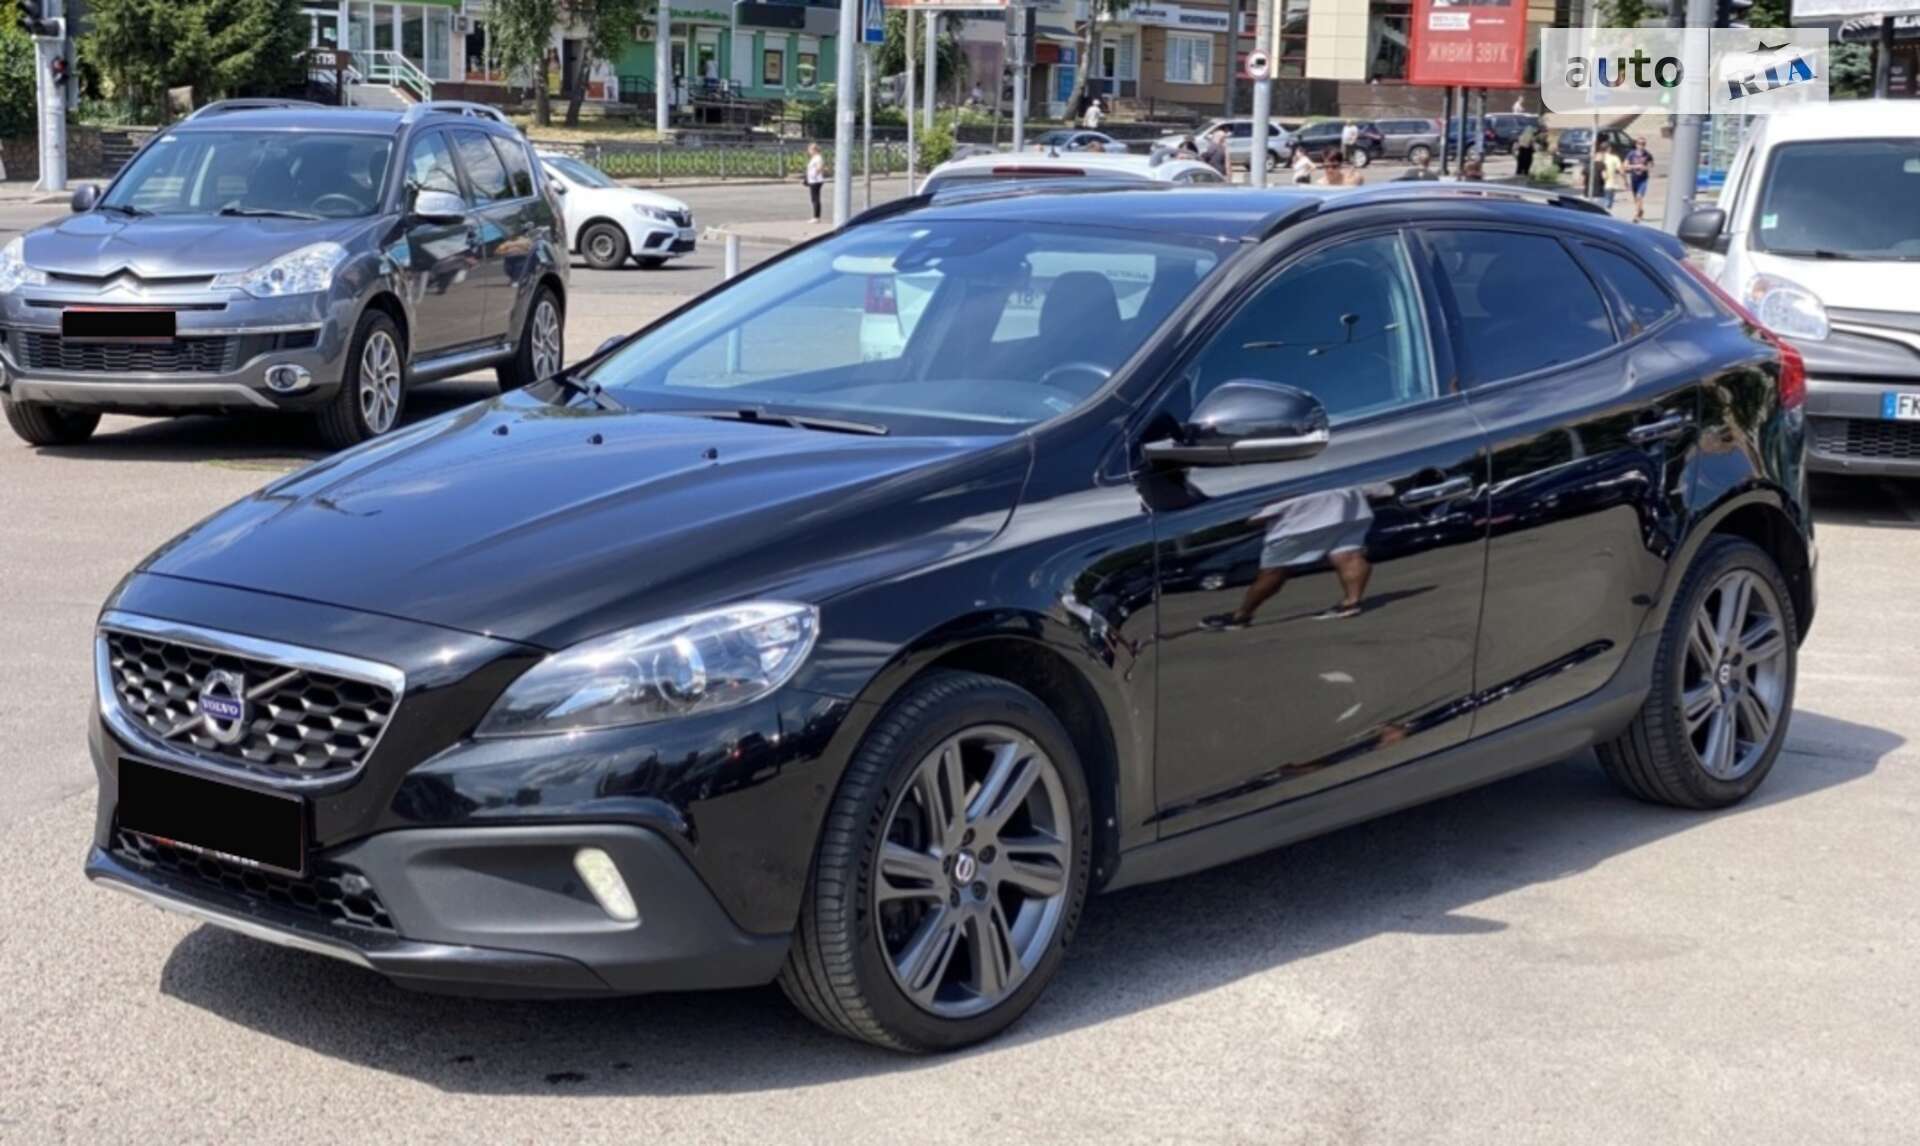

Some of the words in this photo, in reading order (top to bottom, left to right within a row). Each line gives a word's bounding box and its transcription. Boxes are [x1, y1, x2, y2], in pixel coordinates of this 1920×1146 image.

[1427, 39, 1472, 63] ЖИВИЙ
[1475, 42, 1509, 63] ЗВУК
[202, 699, 238, 716] VOLVO
